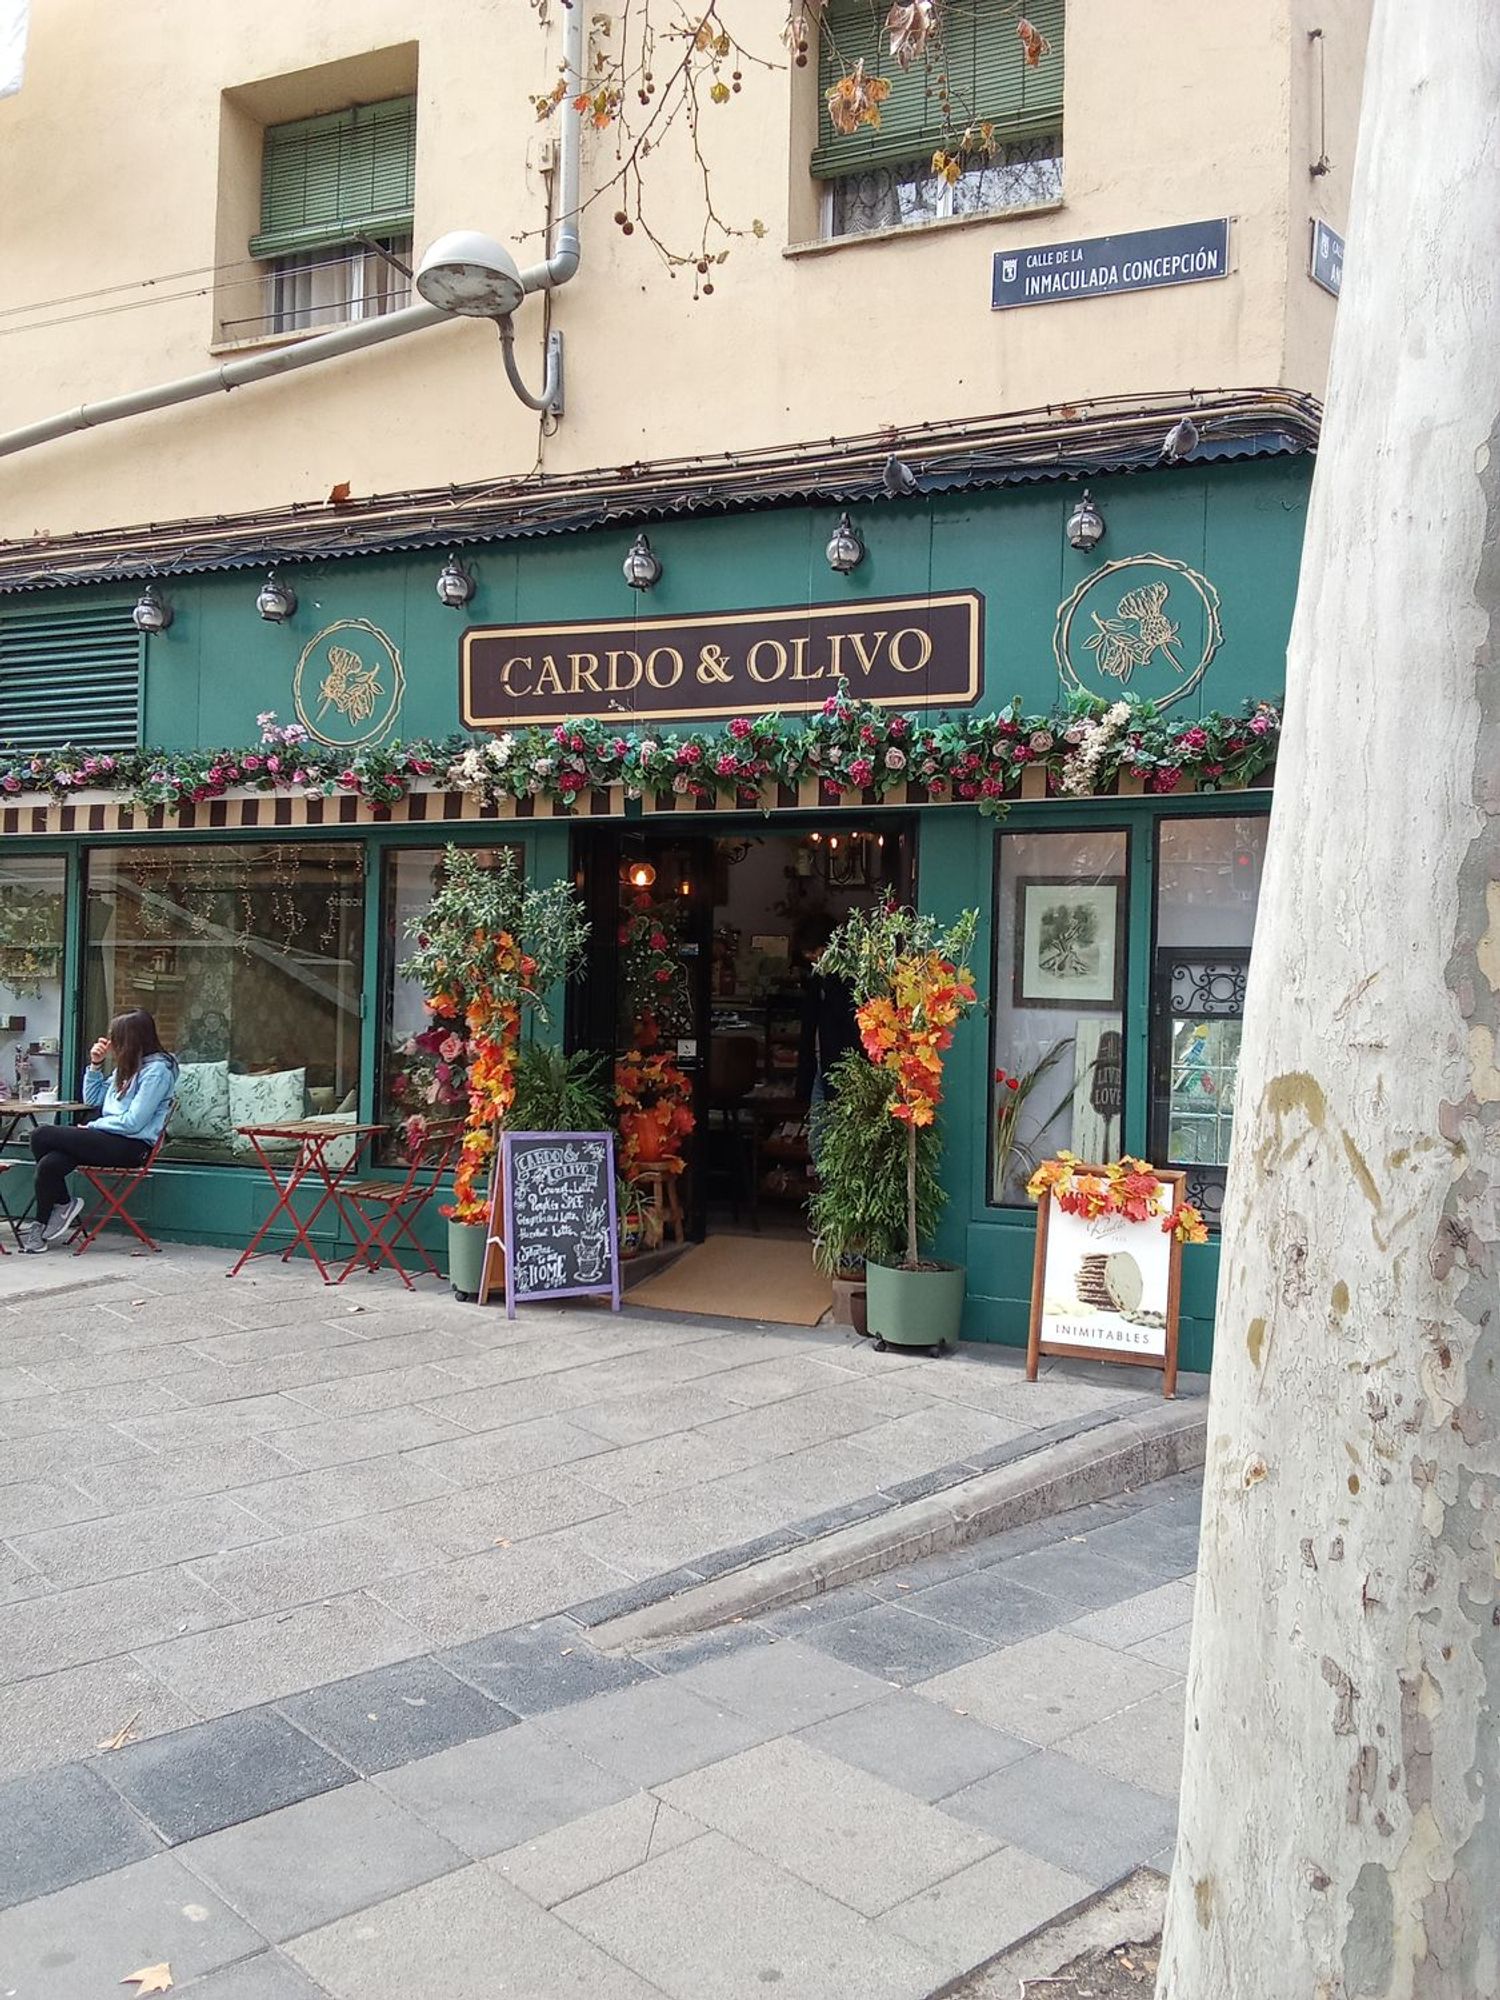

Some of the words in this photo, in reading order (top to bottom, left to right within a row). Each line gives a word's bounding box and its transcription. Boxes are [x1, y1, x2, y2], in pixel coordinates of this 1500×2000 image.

[1026, 252, 1054, 268] CALLE
[1056, 250, 1069, 264] DE
[1071, 248, 1084, 262] LA
[1025, 265, 1119, 296] INMACULADA
[1122, 246, 1218, 282] CONCEPCIÓN
[501, 645, 684, 697] CARDO
[696, 643, 735, 684] &
[746, 627, 933, 683] OLIVO
[1094, 1087, 1122, 1106] LOVE
[518, 1149, 561, 1170] CARDO
[563, 1143, 580, 1162] &
[554, 1163, 589, 1179] OLIVO
[527, 1254, 567, 1288] HOME
[1056, 1324, 1150, 1344] INIMITABLES
